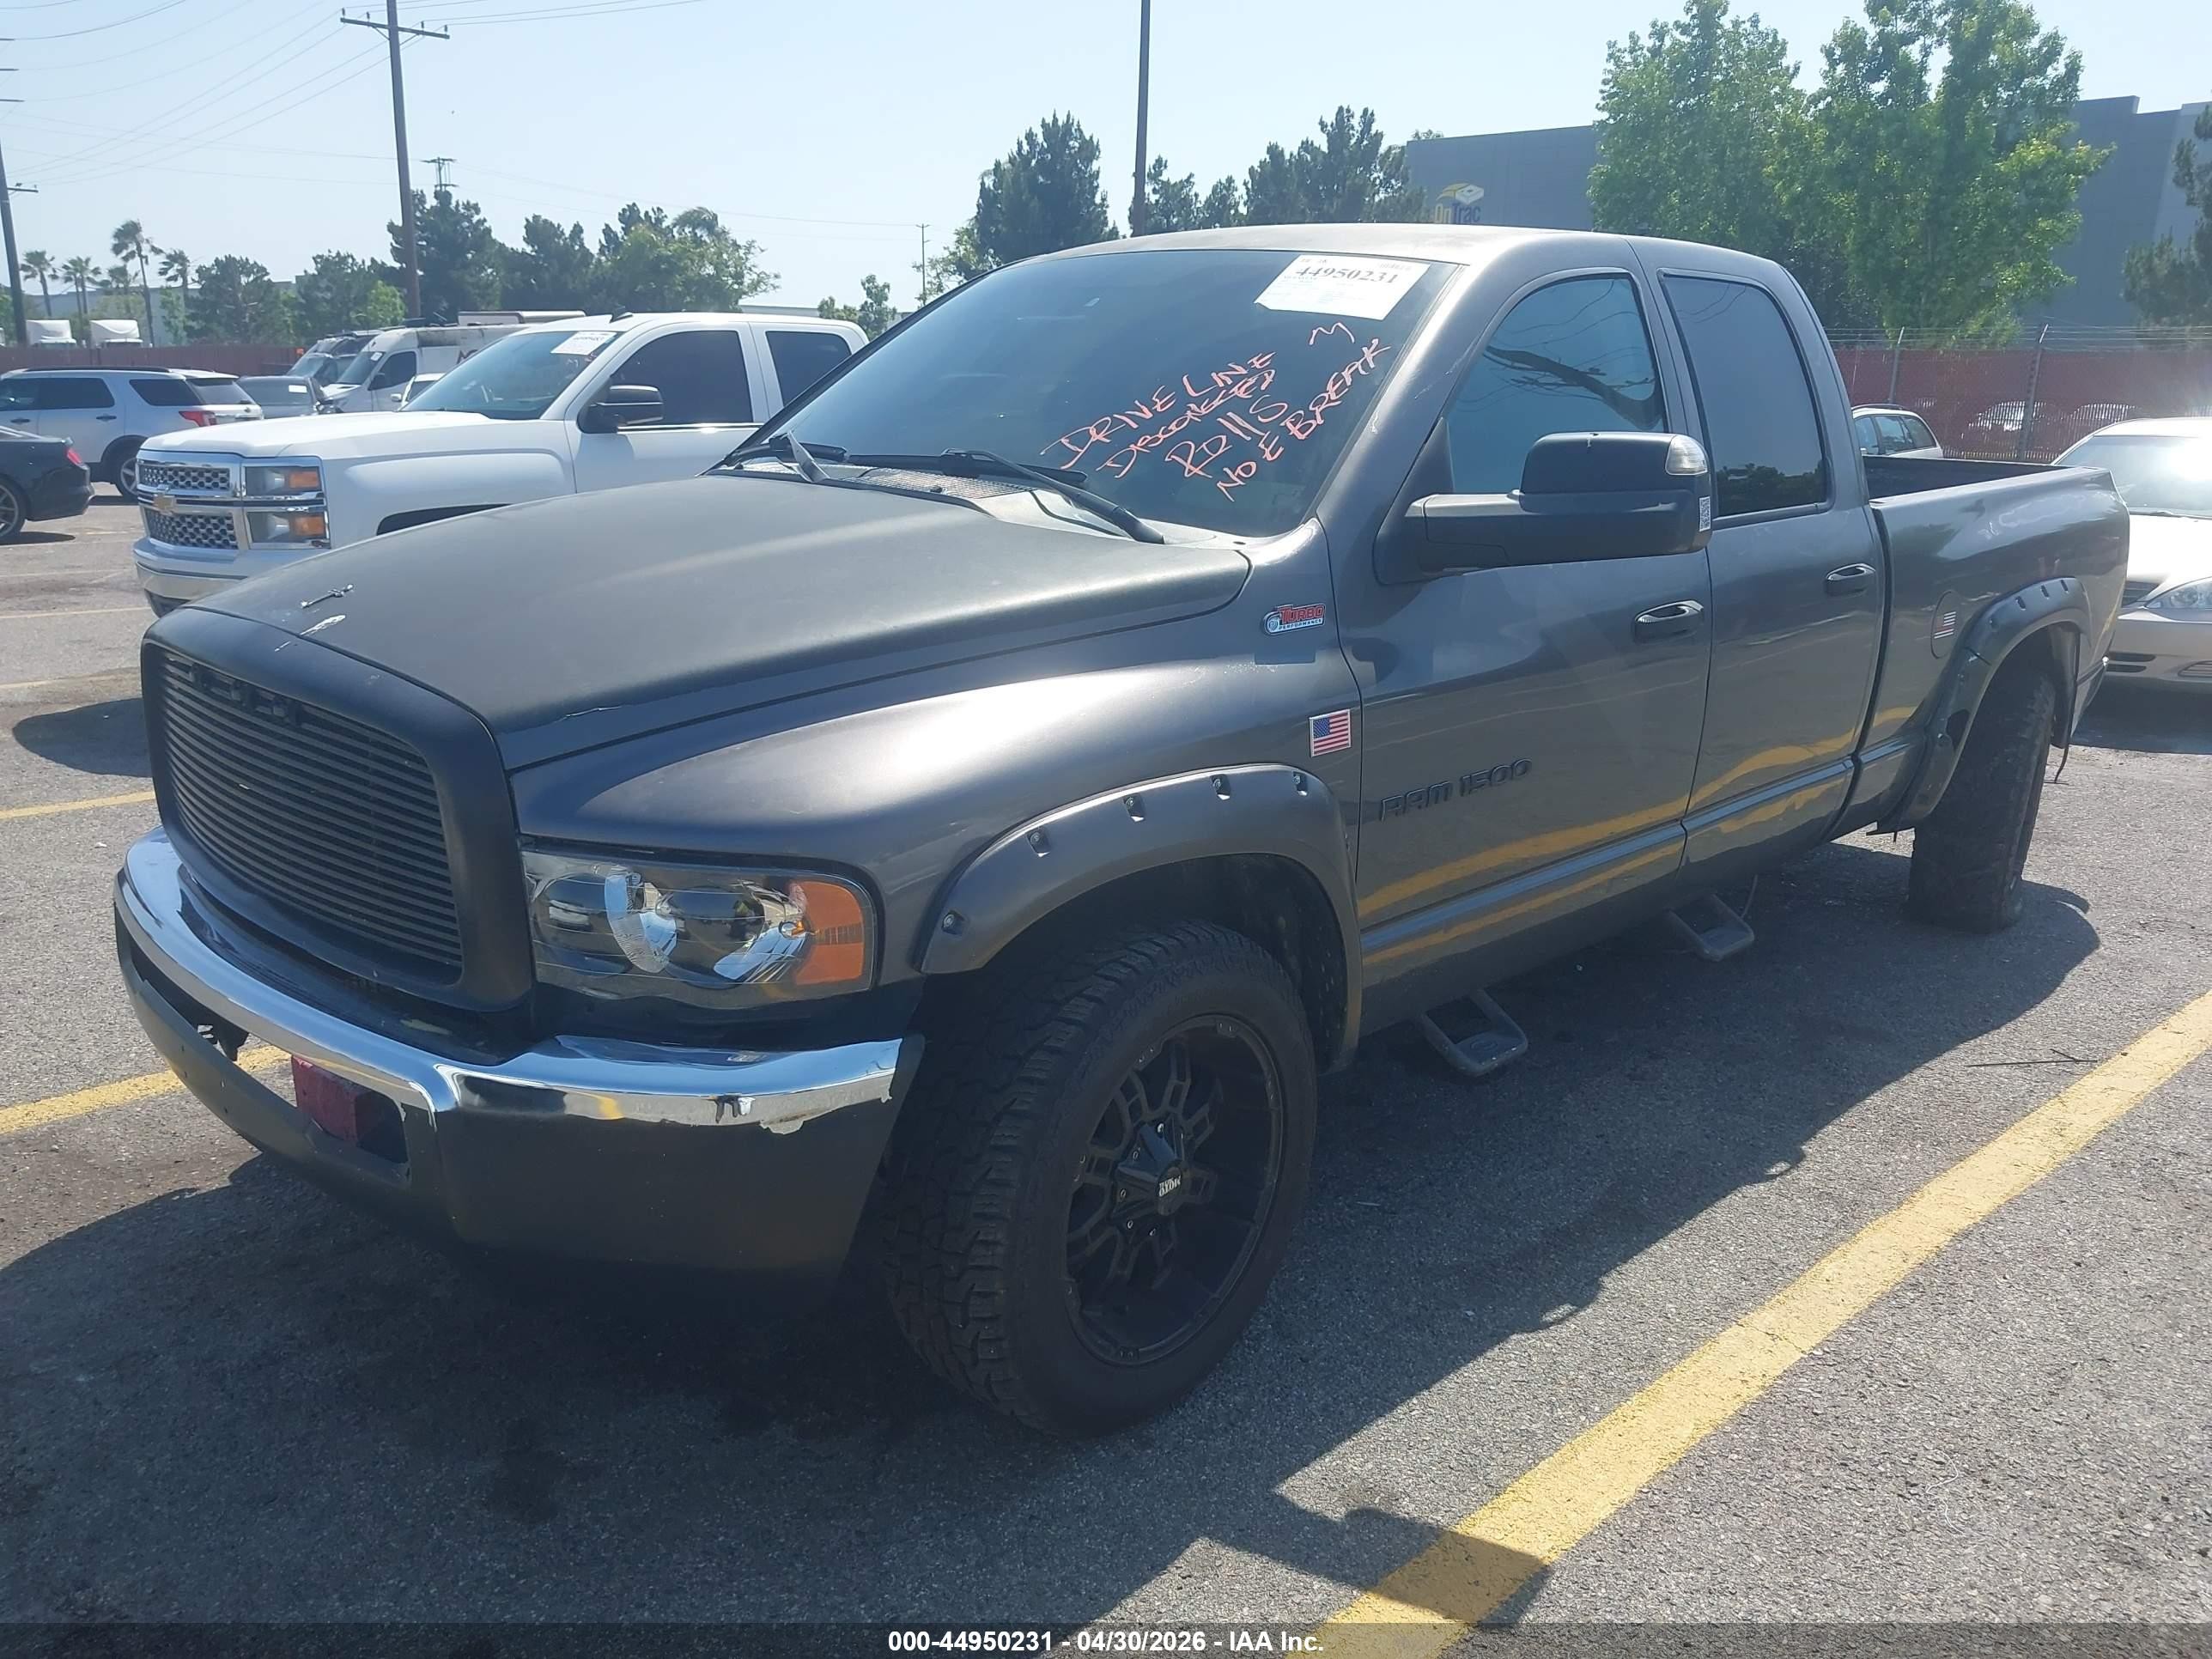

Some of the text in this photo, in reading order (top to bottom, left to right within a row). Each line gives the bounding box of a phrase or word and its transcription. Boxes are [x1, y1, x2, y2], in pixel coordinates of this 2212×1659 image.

[1295, 266, 1399, 284] 44950231
[1040, 351, 1277, 470] DRIVE LINE
[1278, 605, 1324, 625] TURBO
[1279, 618, 1322, 630] PERFORMANCE
[1379, 758, 1533, 823] RAM 1500
